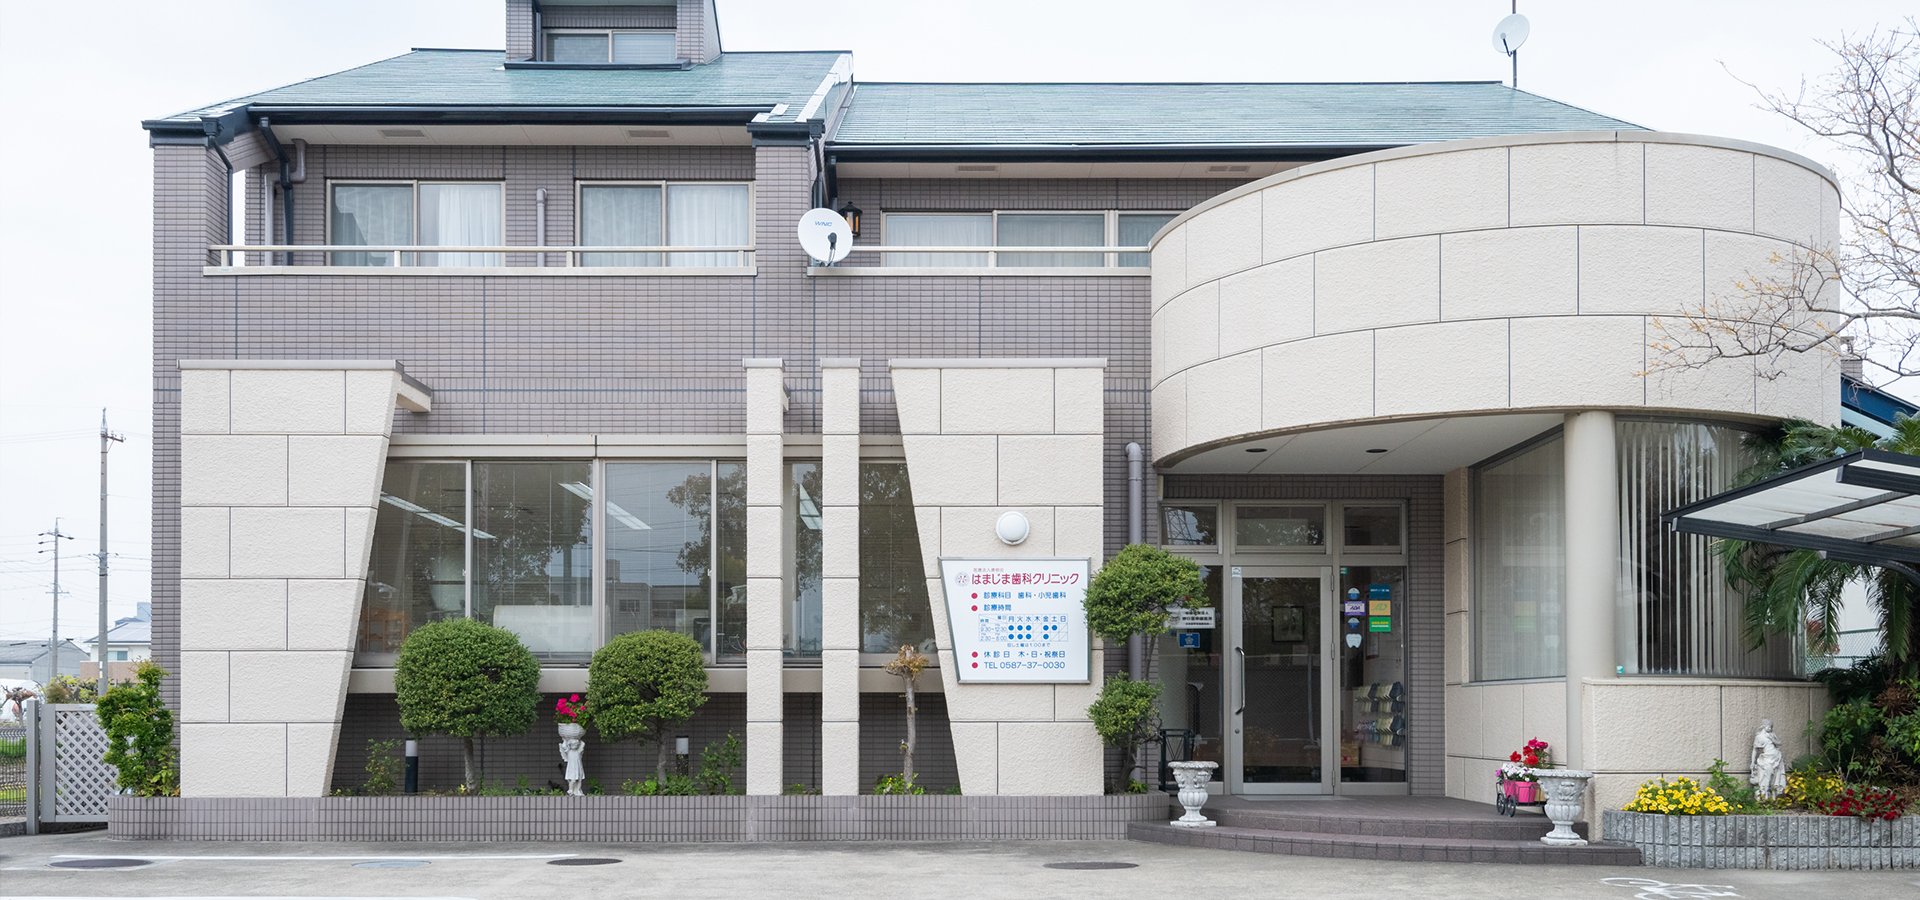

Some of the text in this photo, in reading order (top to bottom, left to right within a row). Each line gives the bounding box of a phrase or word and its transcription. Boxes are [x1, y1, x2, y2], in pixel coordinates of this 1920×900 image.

[971, 573, 1079, 585] はまじま歯科クリニック
[983, 661, 1066, 669] TEL 0587-37-0030
